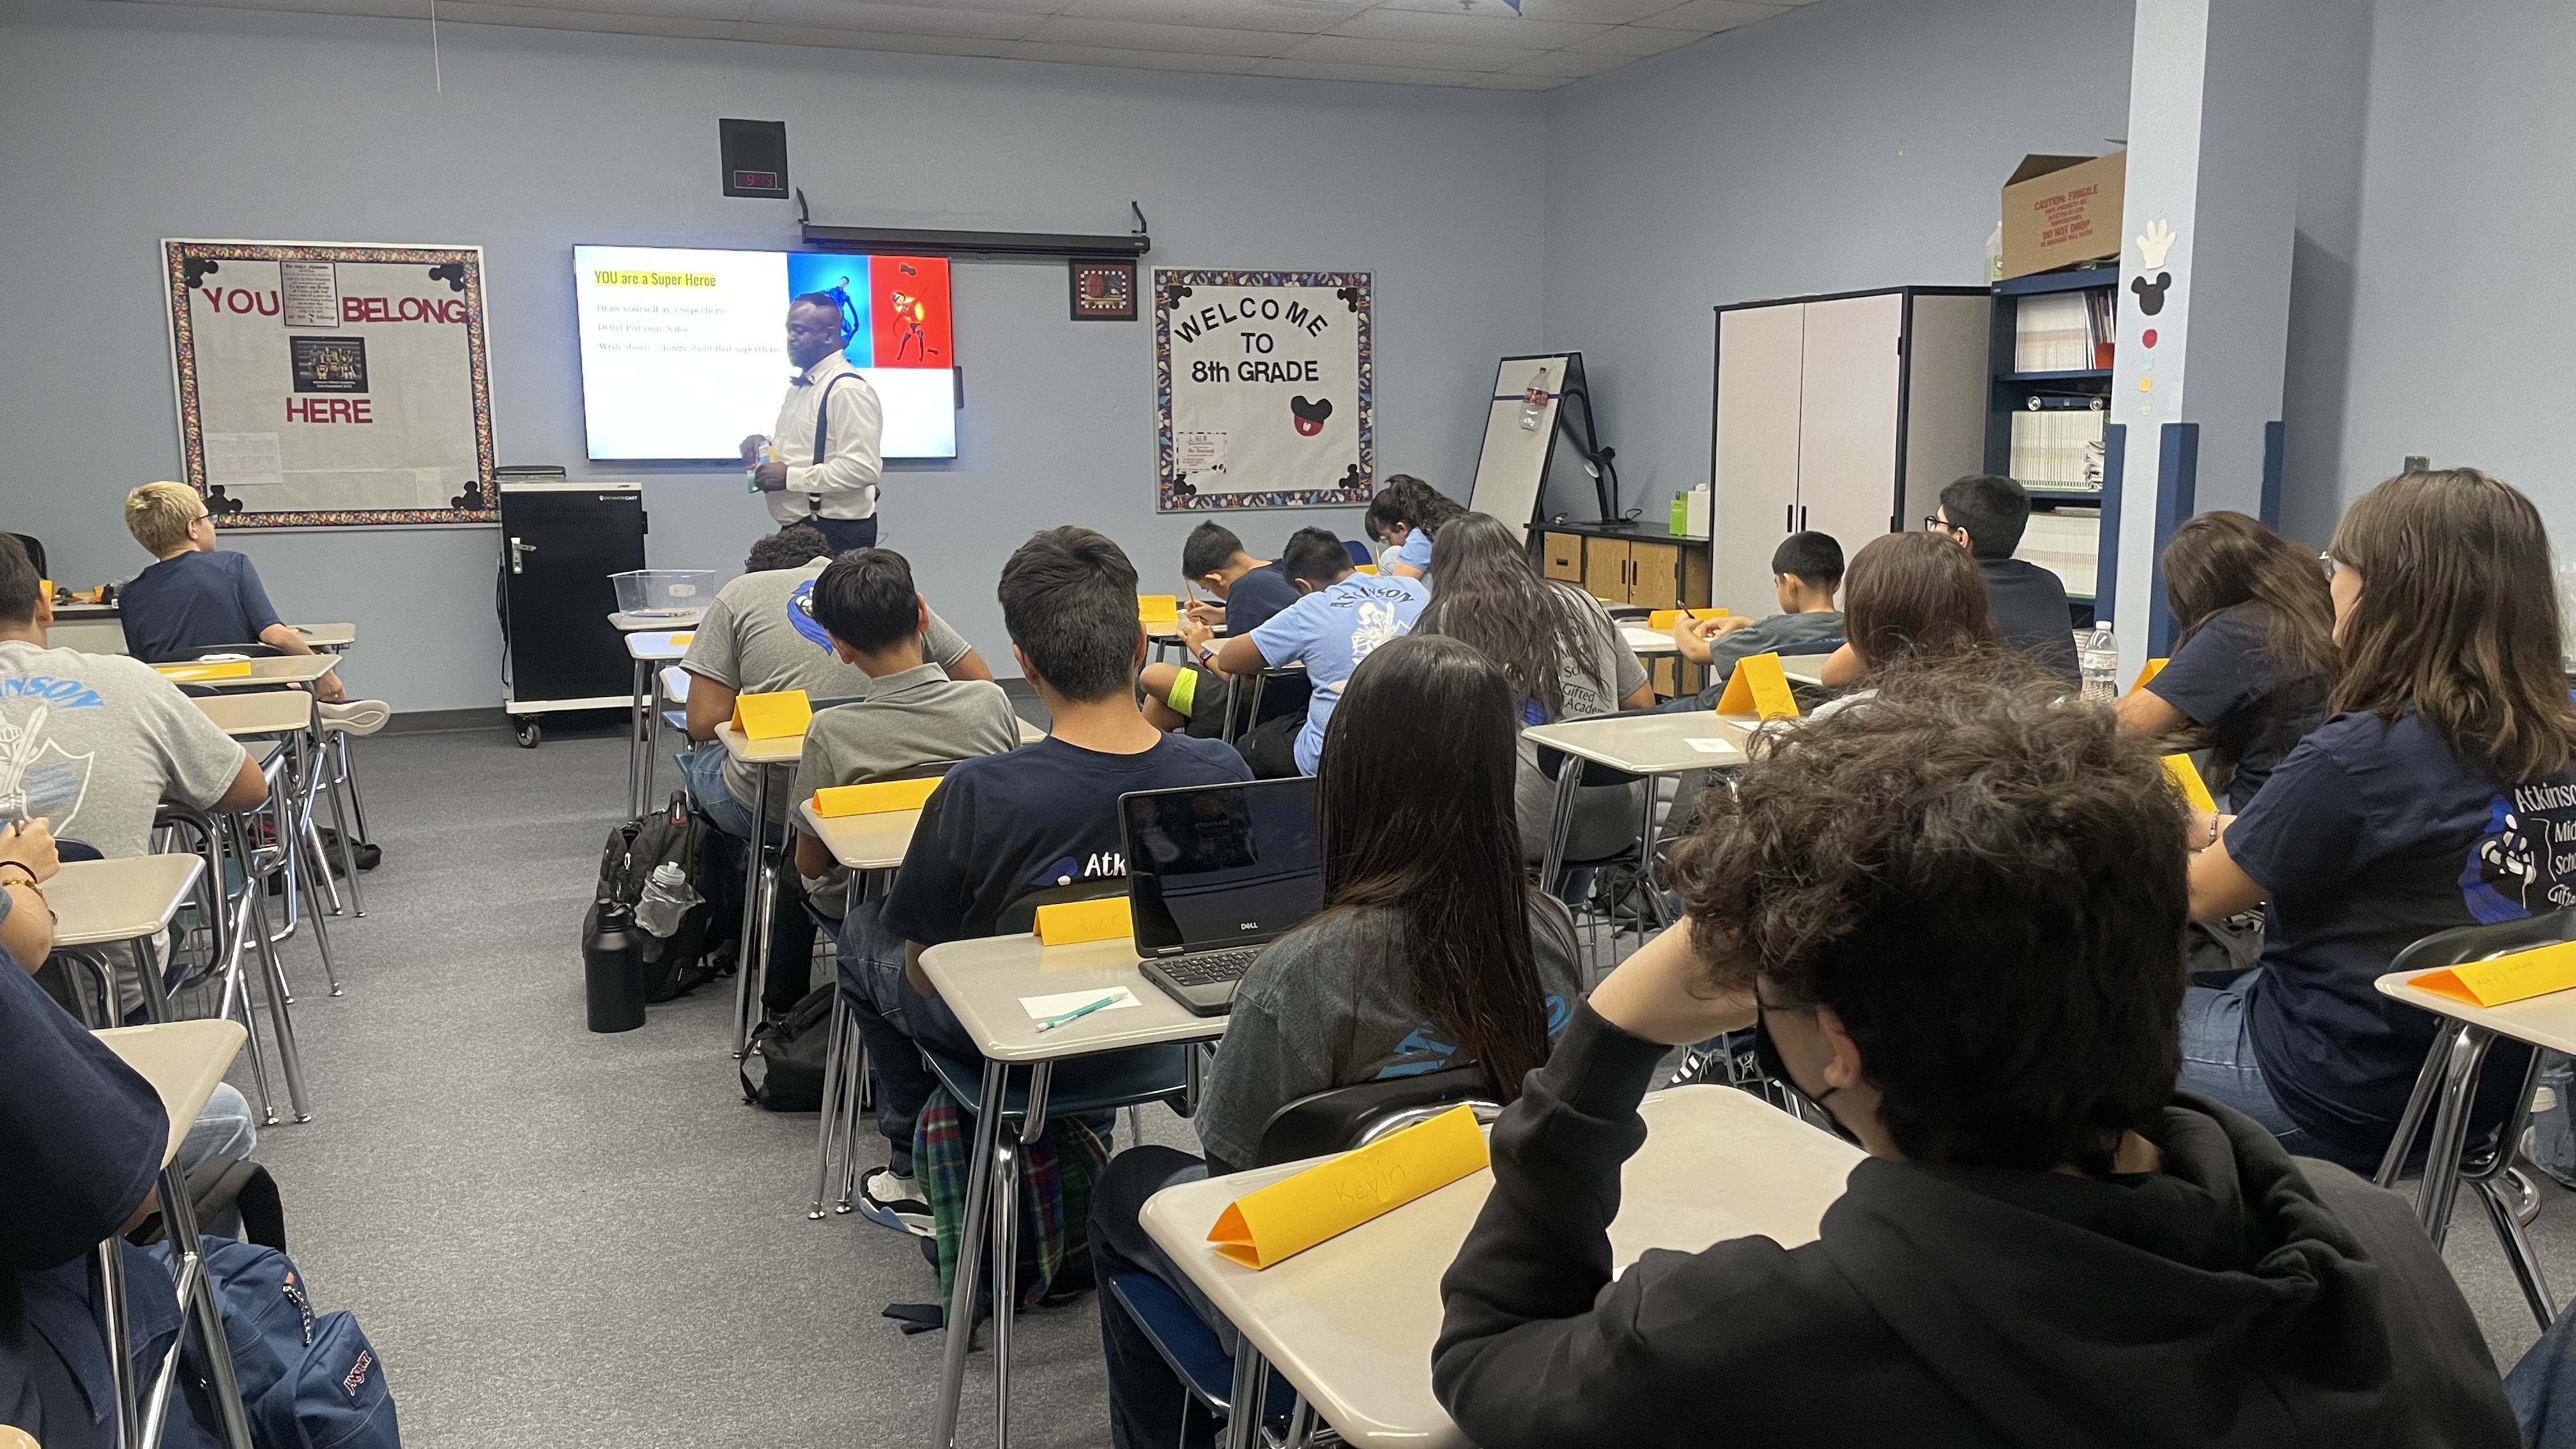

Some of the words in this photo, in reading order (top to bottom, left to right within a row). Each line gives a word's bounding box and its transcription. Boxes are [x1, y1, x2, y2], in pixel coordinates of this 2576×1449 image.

[2069, 185, 2097, 201] FRAGILE
[2043, 229, 2053, 241] DO
[2055, 225, 2069, 237] NOT
[2071, 218, 2090, 233] DROP
[595, 271, 618, 284] YOU
[621, 275, 639, 285] are
[641, 275, 648, 285] a
[651, 273, 682, 288] Super
[685, 273, 716, 287] Heroe
[202, 287, 280, 316] YOU
[342, 296, 467, 324] BELONG
[1174, 298, 1328, 344] WELCOME
[1240, 332, 1273, 353] TO
[1192, 361, 1230, 383] 8th
[1238, 360, 1319, 383] GRADE
[286, 397, 372, 423] HERE
[1330, 587, 1415, 608] ATKINSON
[1563, 684, 1595, 702] Gifted
[1084, 852, 1126, 877] Atk
[1241, 922, 1258, 930] DELL
[1334, 1160, 1407, 1212] Kevin
